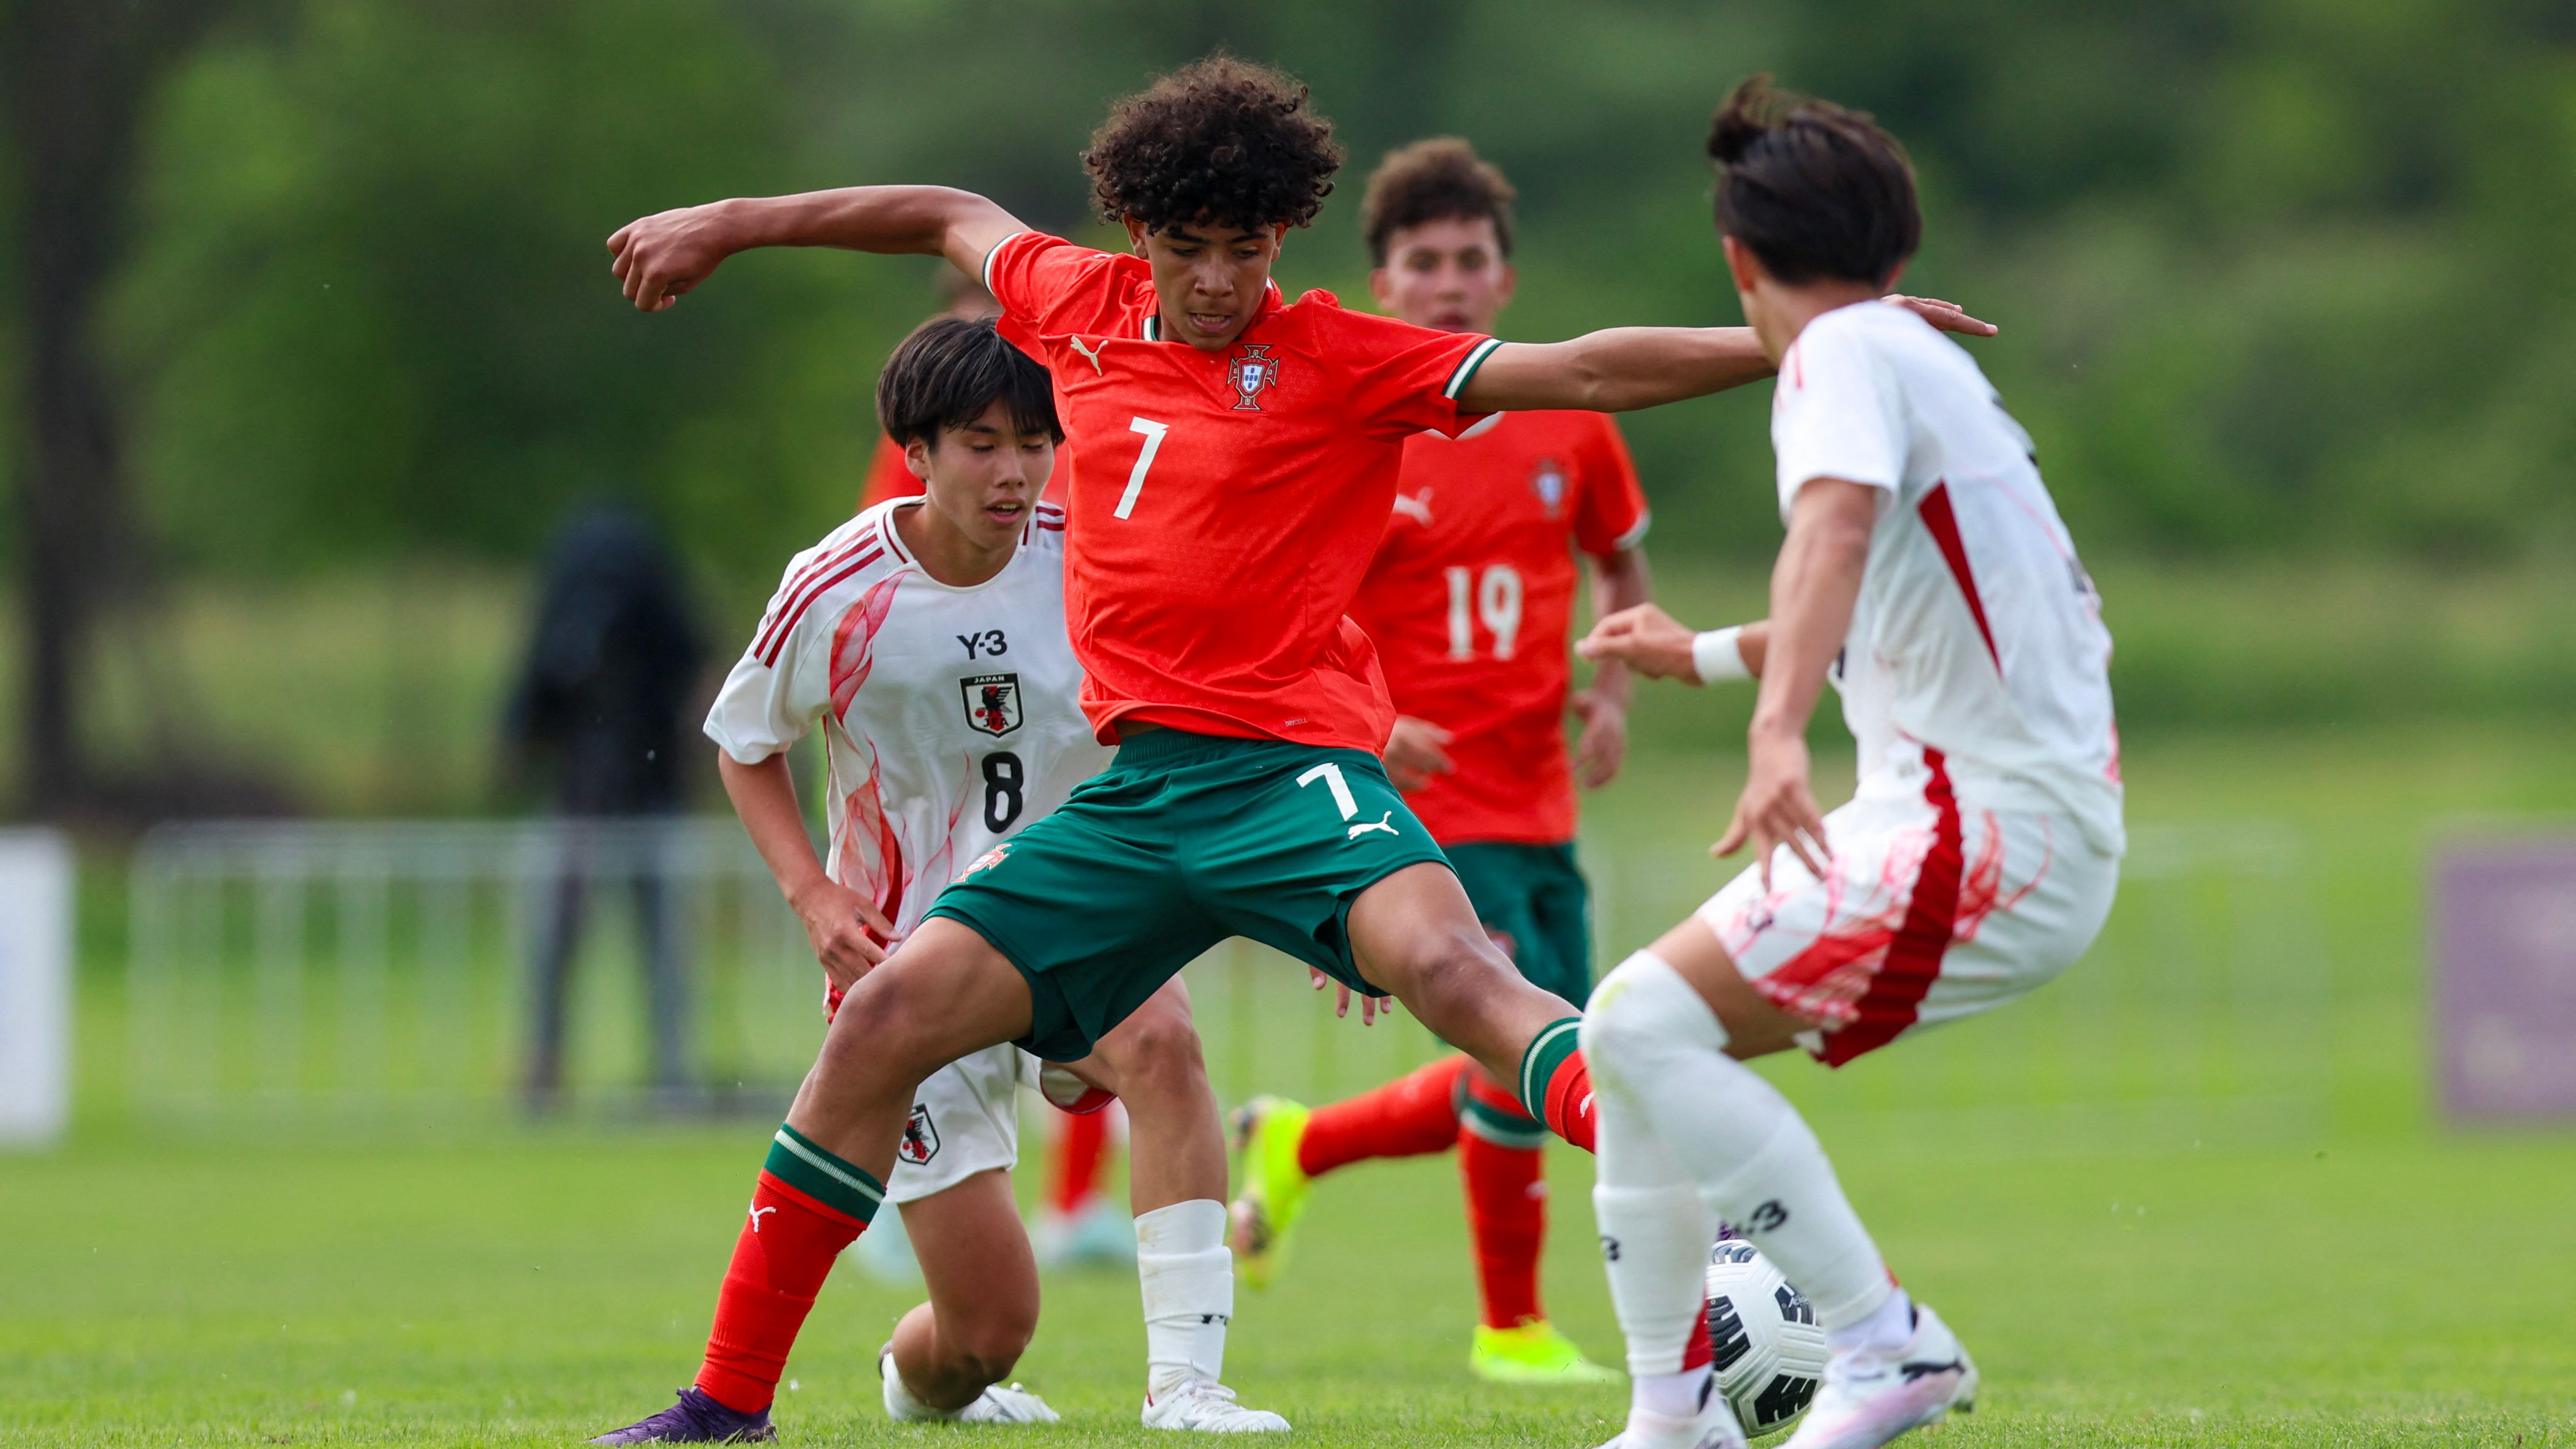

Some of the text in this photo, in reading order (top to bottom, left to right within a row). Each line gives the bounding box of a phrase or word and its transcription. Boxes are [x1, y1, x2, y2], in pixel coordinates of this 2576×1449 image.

[1113, 416, 1170, 520] 7
[1443, 564, 1523, 662] 19
[956, 629, 1008, 660] Y-3
[974, 675, 1005, 684] JAPAN
[983, 717, 1009, 727] JFA
[981, 750, 1024, 834] 8
[1295, 762, 1359, 822] 7
